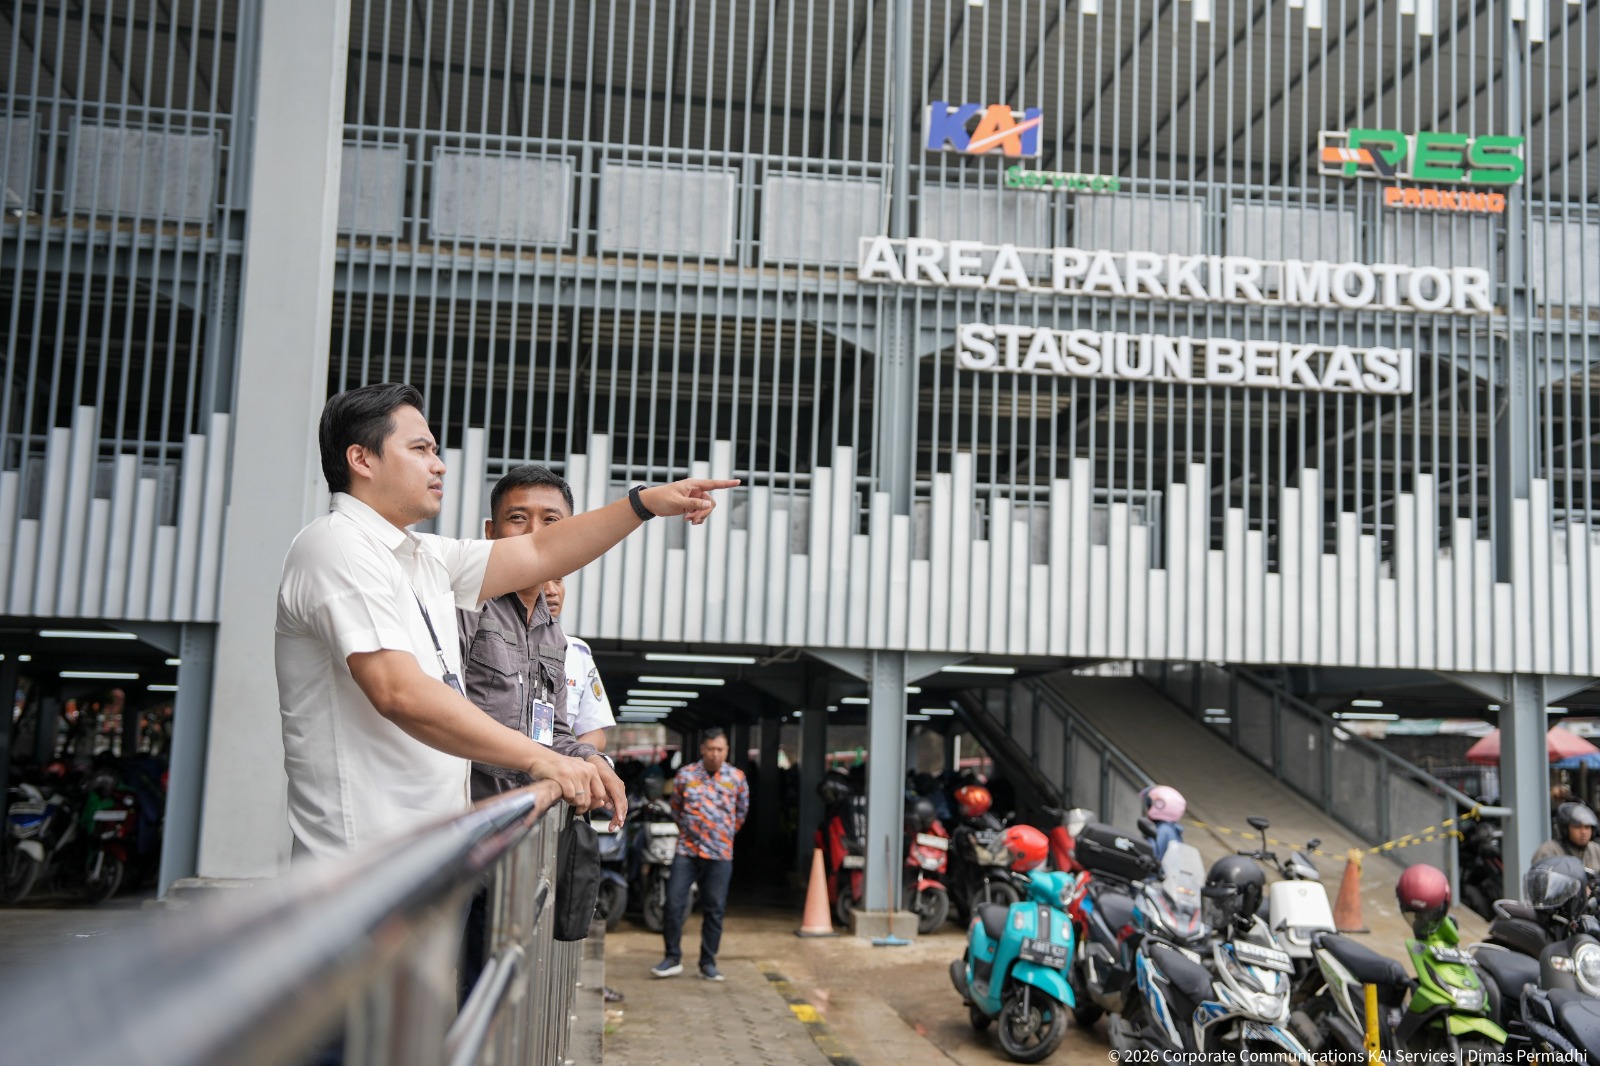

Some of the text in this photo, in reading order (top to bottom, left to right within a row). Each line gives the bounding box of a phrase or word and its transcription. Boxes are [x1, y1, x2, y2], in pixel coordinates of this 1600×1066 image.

[928, 101, 1042, 157] KAI
[1321, 128, 1526, 184] RES
[1006, 165, 1121, 193] Services
[1384, 186, 1505, 213] PARKING
[858, 235, 1494, 313] AREA PARKIR MOTOR
[959, 322, 1413, 395] STASIUN BEKASI
